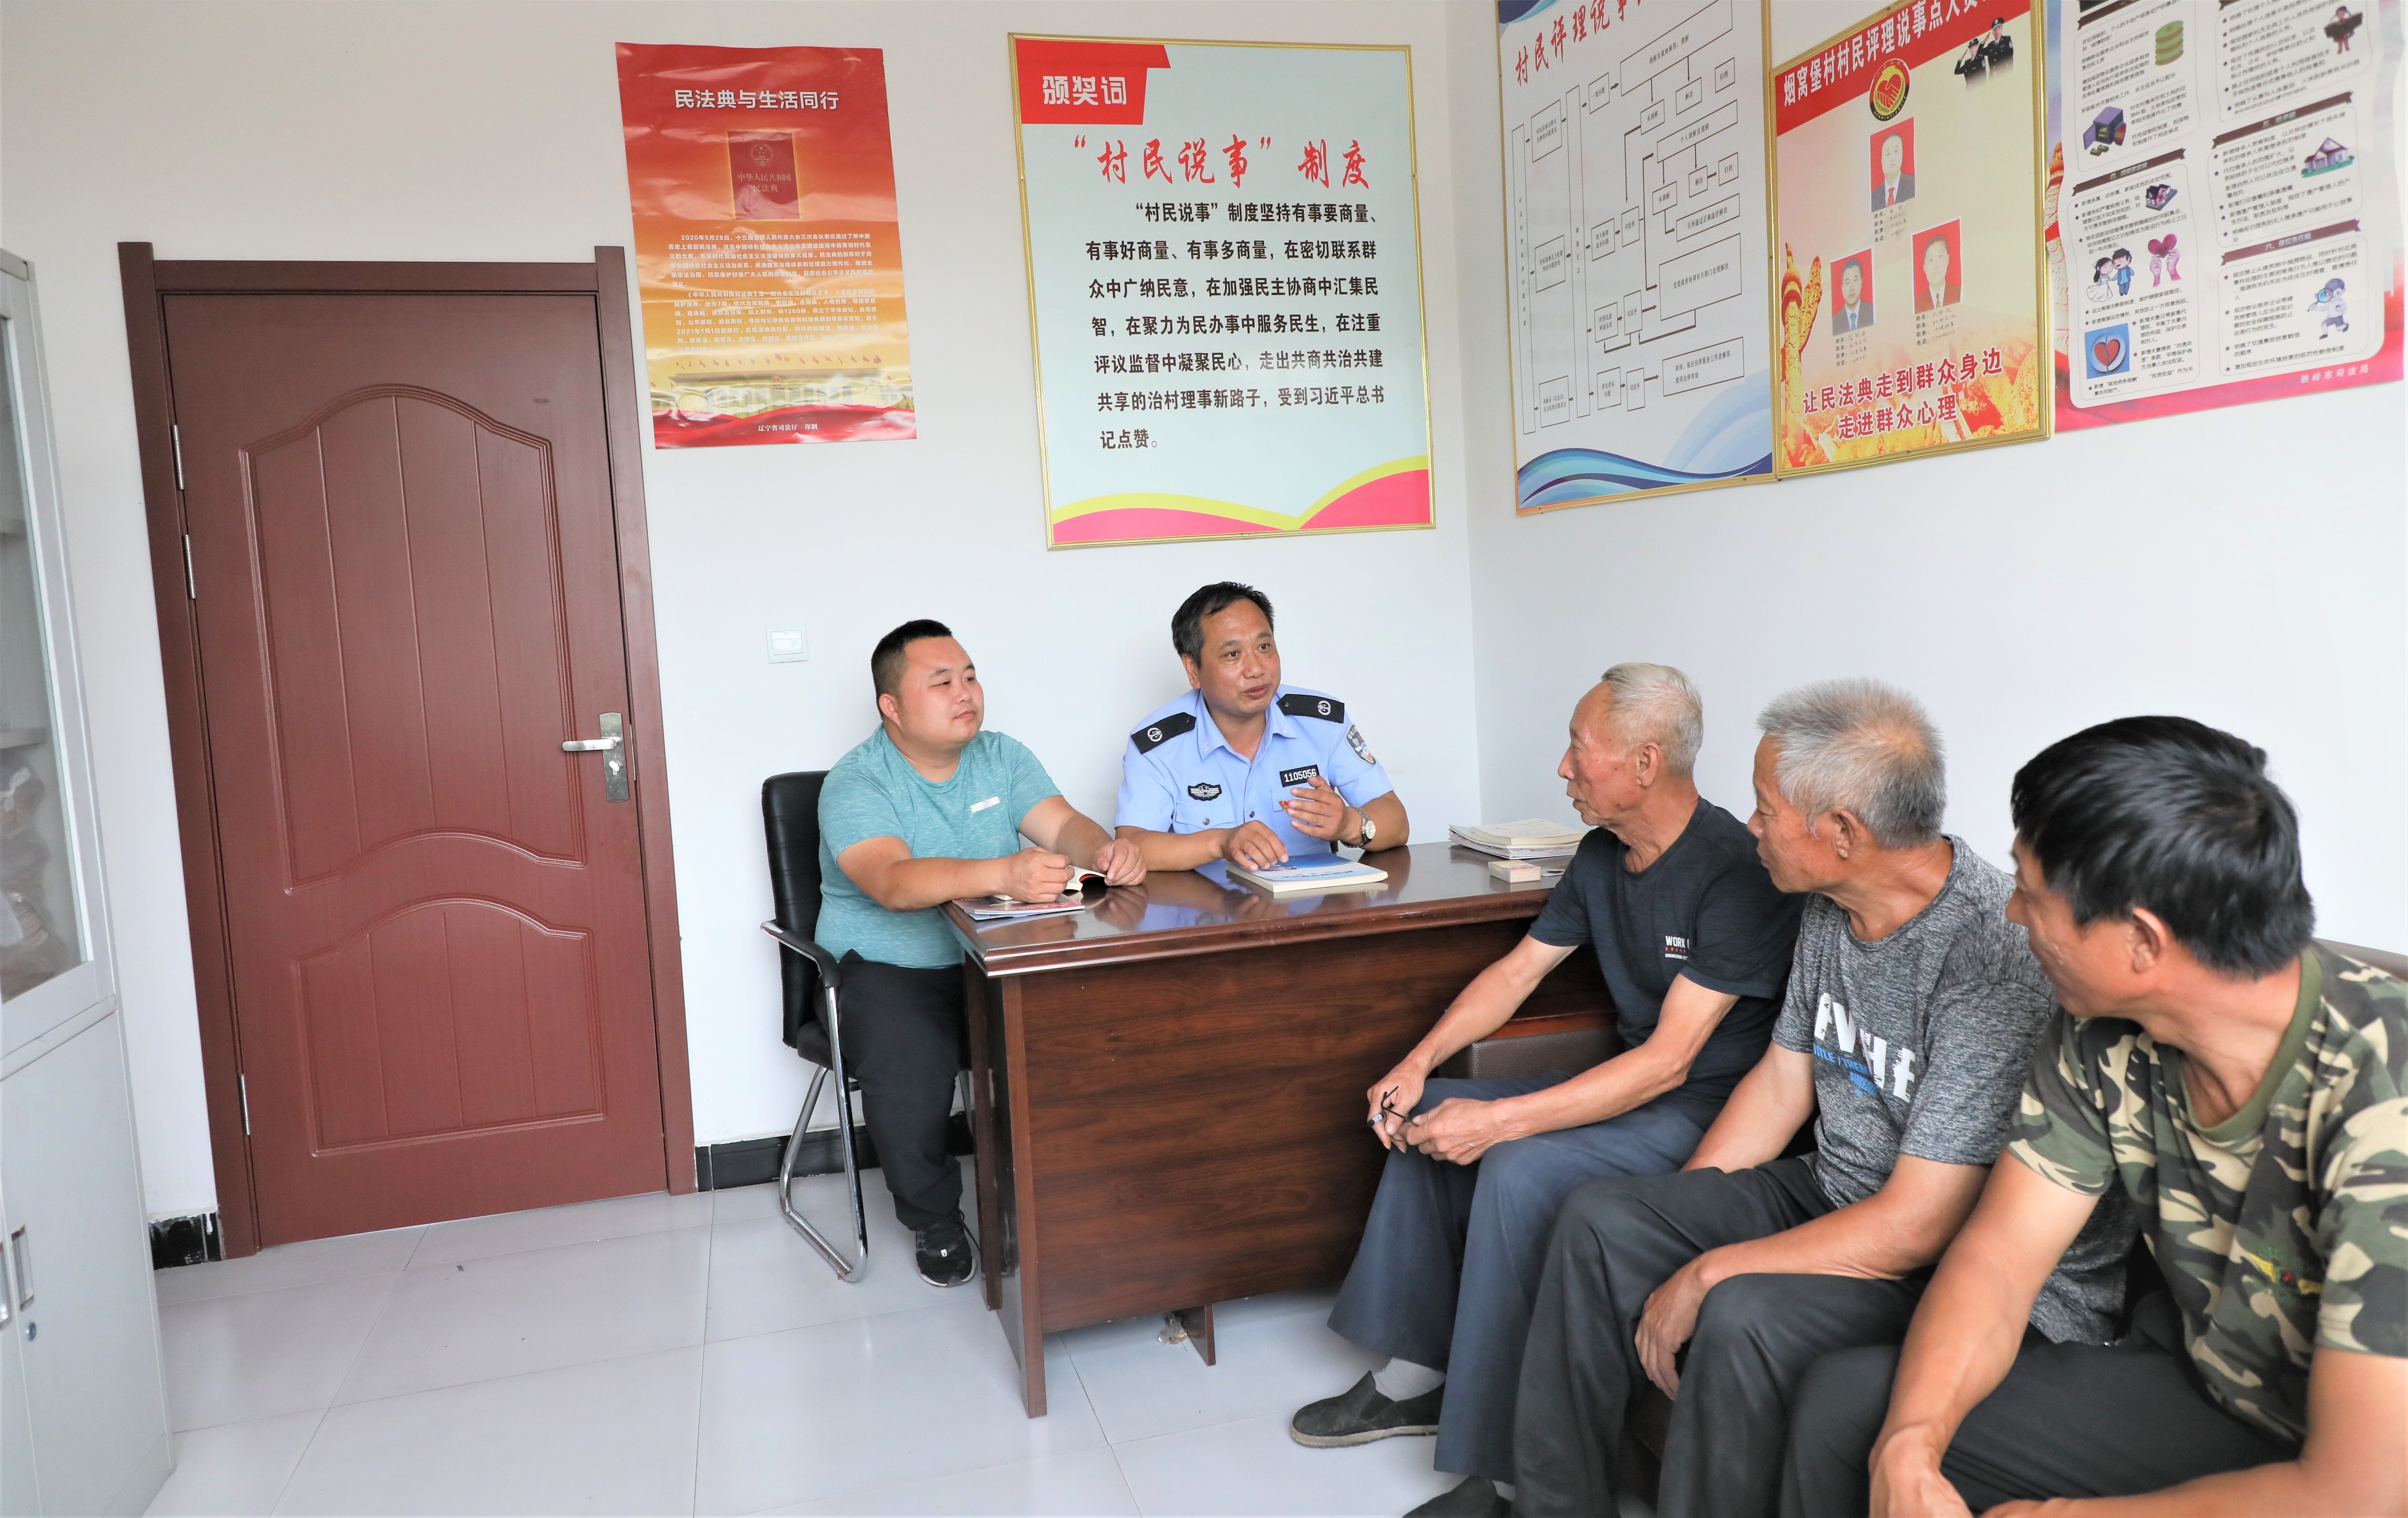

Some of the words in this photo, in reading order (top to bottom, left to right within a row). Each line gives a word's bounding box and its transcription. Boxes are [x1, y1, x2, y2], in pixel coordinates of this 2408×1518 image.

[675, 89, 839, 110] 民法典与生活同行
[1042, 76, 1128, 105] 颁奖词
[737, 172, 791, 182] 中华人民共和国
[753, 184, 778, 192] 民法典
[1086, 239, 1377, 261] 有事好商量、有事多商量，在密切联系群
[1089, 276, 1379, 299] 众中广纳民意，在加强民主协商中汇集民
[1091, 313, 1381, 337] 智，在聚力为民办事中服务民生，在注重
[1094, 349, 1384, 374] 评议监督中凝聚民心，走出共商共治共建
[1802, 346, 2003, 415] 让民法典走到群众身边
[2300, 364, 2369, 384] 铁岭市司法局
[1098, 385, 1385, 412] 共享的治村理事新路子，受到习近平总书
[1838, 394, 1958, 440] 走进群众心理
[758, 424, 798, 432] 辽宁省司法厅
[1100, 429, 1158, 449] 记点赞。
[1284, 768, 1317, 783] 1105056
[1665, 936, 1686, 948] WORK
